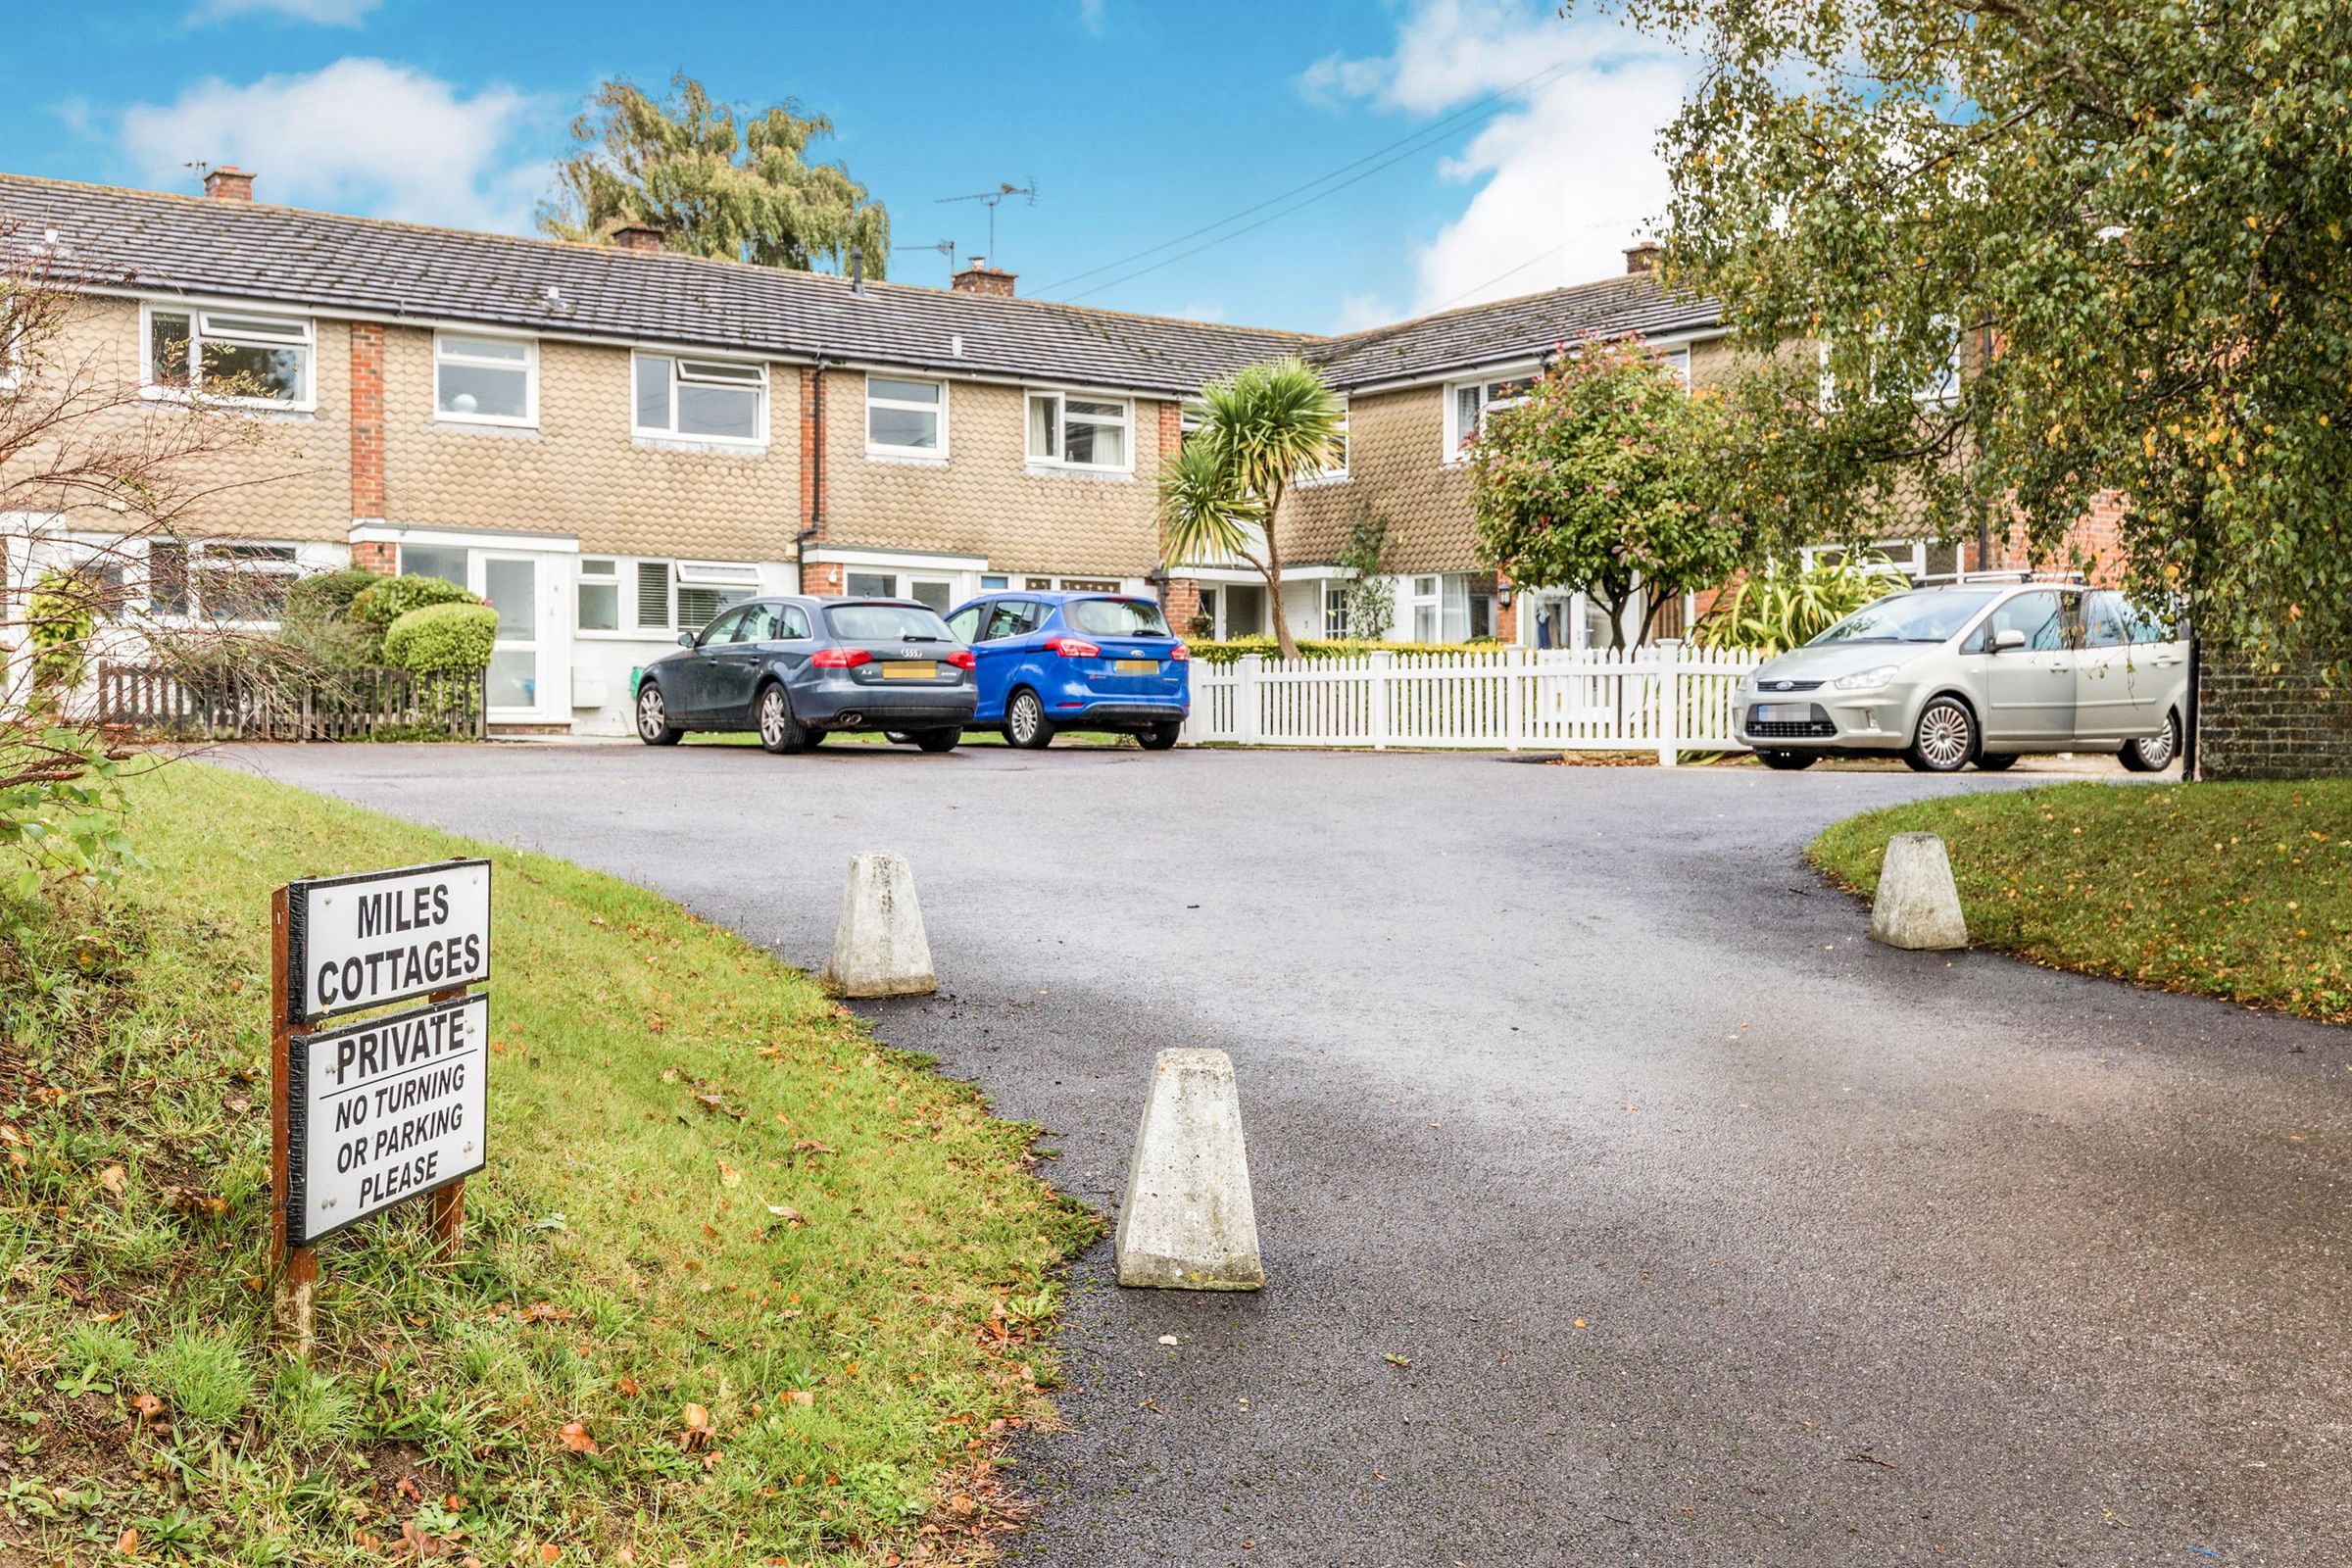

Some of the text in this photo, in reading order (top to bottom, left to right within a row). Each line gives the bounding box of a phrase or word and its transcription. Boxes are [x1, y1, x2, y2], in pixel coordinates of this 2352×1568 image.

[358, 884, 448, 939] MILES
[318, 934, 479, 1005] COTTAGES
[337, 1008, 465, 1085] PRIVATE
[336, 1063, 465, 1133] NO TURNING
[337, 1103, 463, 1173] OR PARKING
[359, 1151, 438, 1208] PLEASE
